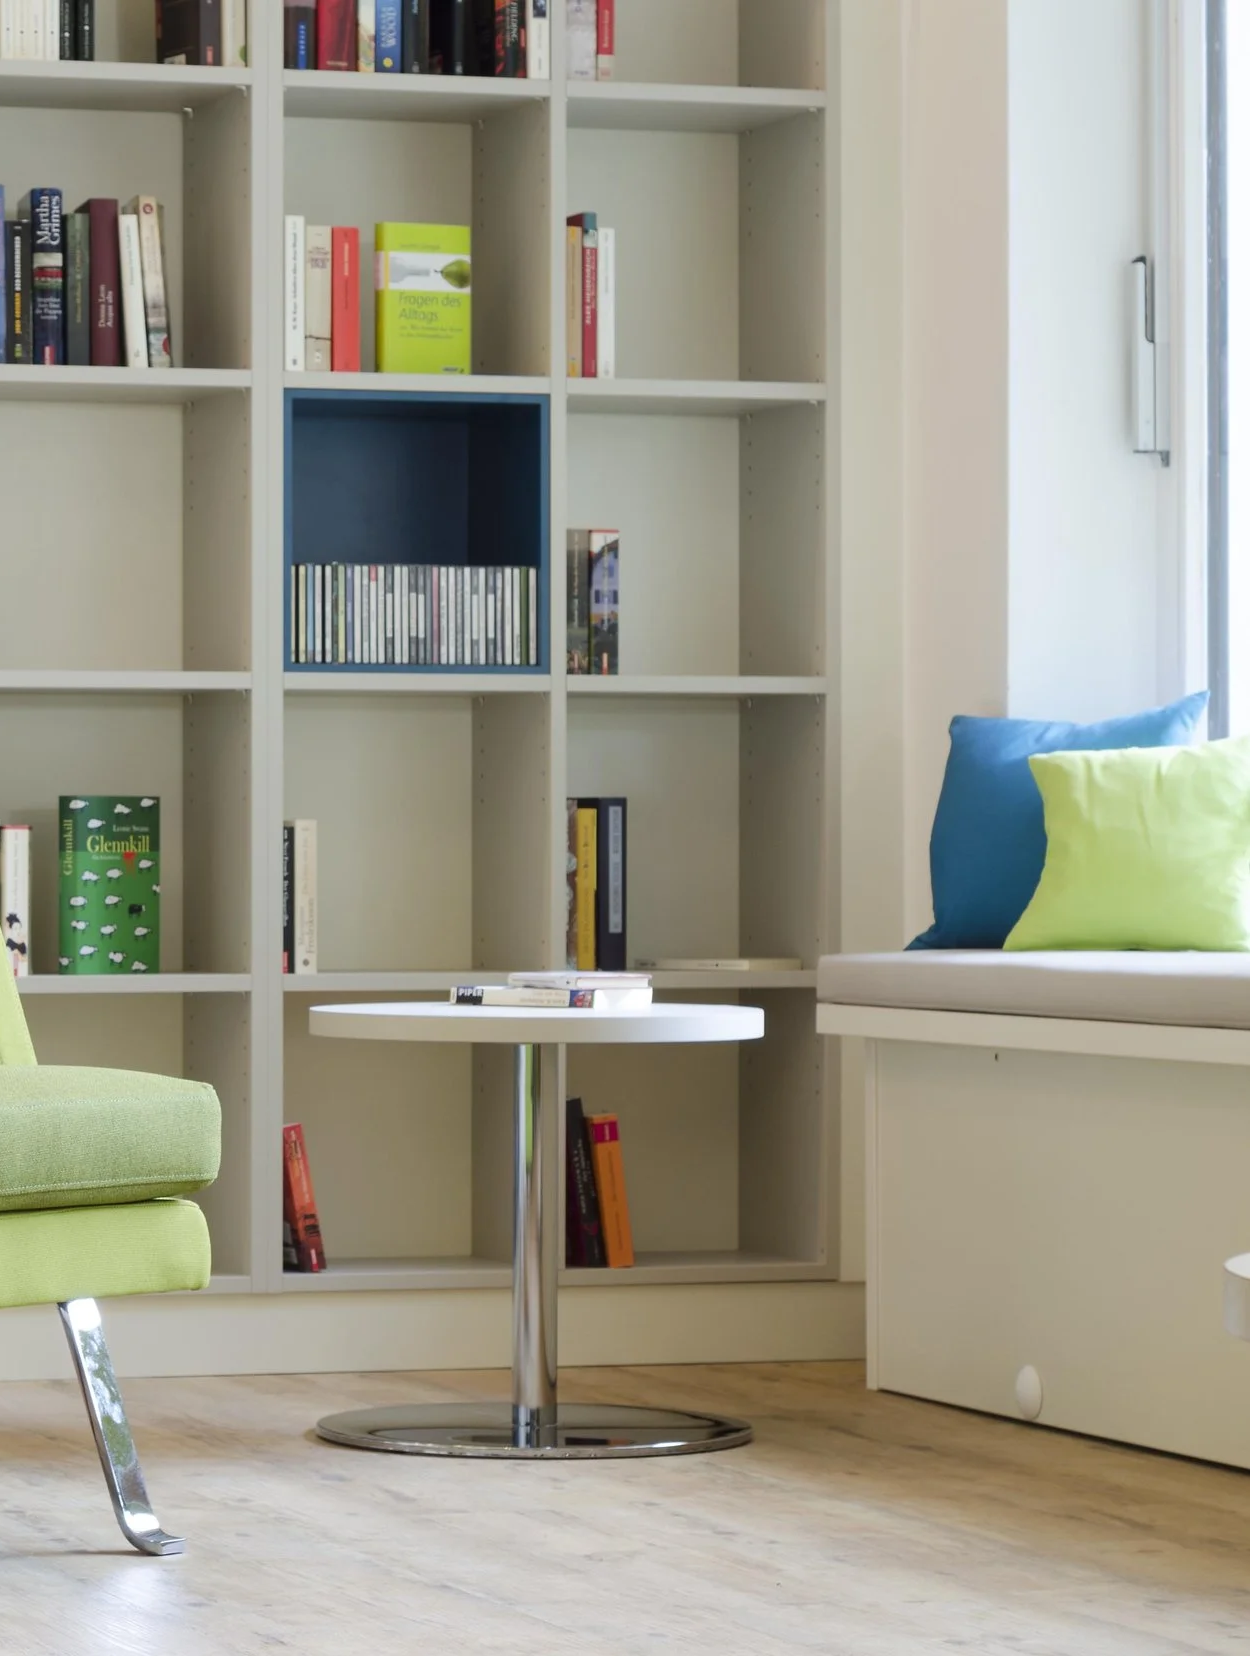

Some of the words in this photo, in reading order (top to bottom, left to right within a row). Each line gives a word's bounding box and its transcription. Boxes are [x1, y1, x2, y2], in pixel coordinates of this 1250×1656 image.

[35, 195, 50, 246] Martha
[49, 195, 61, 246] Grimes
[98, 284, 106, 303] Leon
[398, 292, 438, 308] Fragen
[441, 294, 462, 308] des
[98, 304, 106, 328] Donna
[398, 308, 439, 325] Alltags
[62, 819, 74, 876] Glennkill
[86, 835, 150, 854] Glennkill
[458, 986, 484, 998] PIPER
